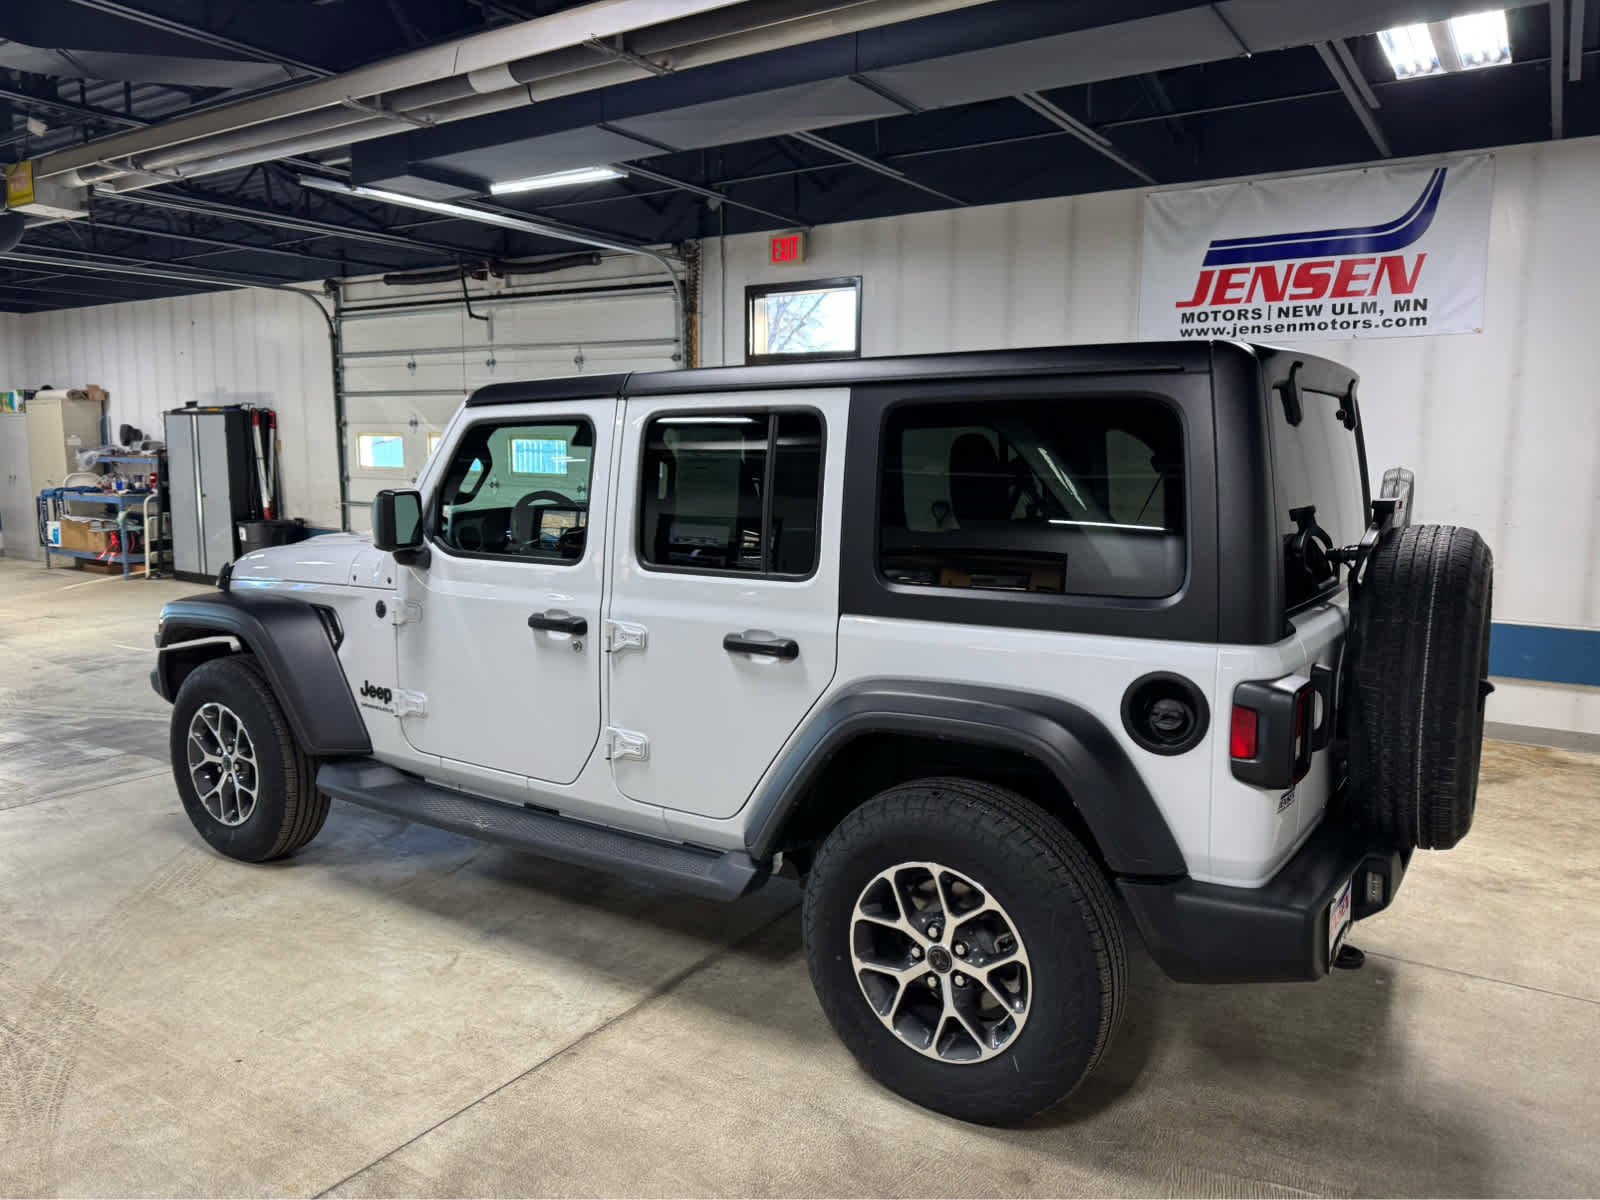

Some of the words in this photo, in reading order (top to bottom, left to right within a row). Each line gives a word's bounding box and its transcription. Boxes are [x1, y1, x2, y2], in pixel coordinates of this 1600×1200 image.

[772, 236, 800, 262] EXIT
[1175, 253, 1428, 308] JENSEN
[1181, 308, 1262, 324] MOTORS
[1277, 304, 1323, 319] NEW
[1331, 301, 1385, 316] ULM,
[1393, 298, 1428, 312] MN
[1180, 316, 1427, 338] www.jensenmotors.com
[360, 680, 392, 704] Jeep
